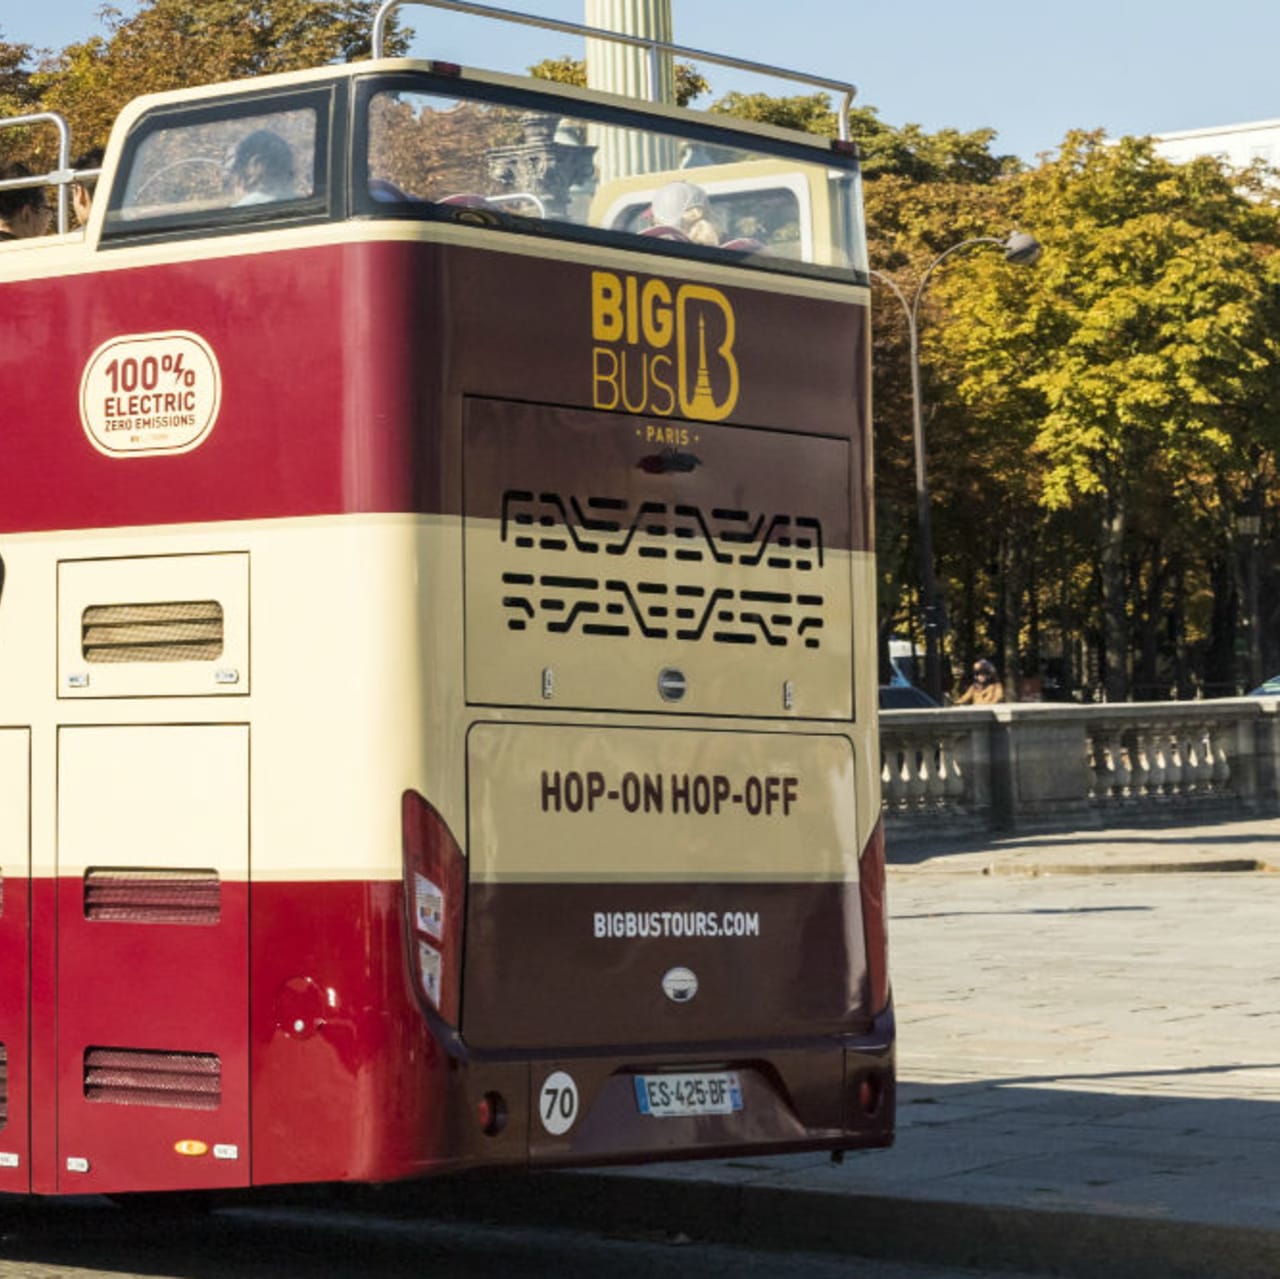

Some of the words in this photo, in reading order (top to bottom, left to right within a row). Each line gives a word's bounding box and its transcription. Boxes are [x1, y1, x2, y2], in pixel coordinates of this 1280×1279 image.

[592, 271, 674, 348] BIG
[105, 353, 195, 394] 100%
[592, 347, 675, 416] BUS
[104, 391, 196, 417] ELECTRIC
[104, 419, 133, 433] ZERO
[135, 414, 196, 430] EMISSIONS
[646, 425, 690, 445] PARIS
[541, 771, 663, 814] HOP-ON
[671, 773, 799, 817] HOP-OFF
[593, 911, 760, 938] BIGBUSTOURS.COM
[544, 1086, 574, 1120] 70
